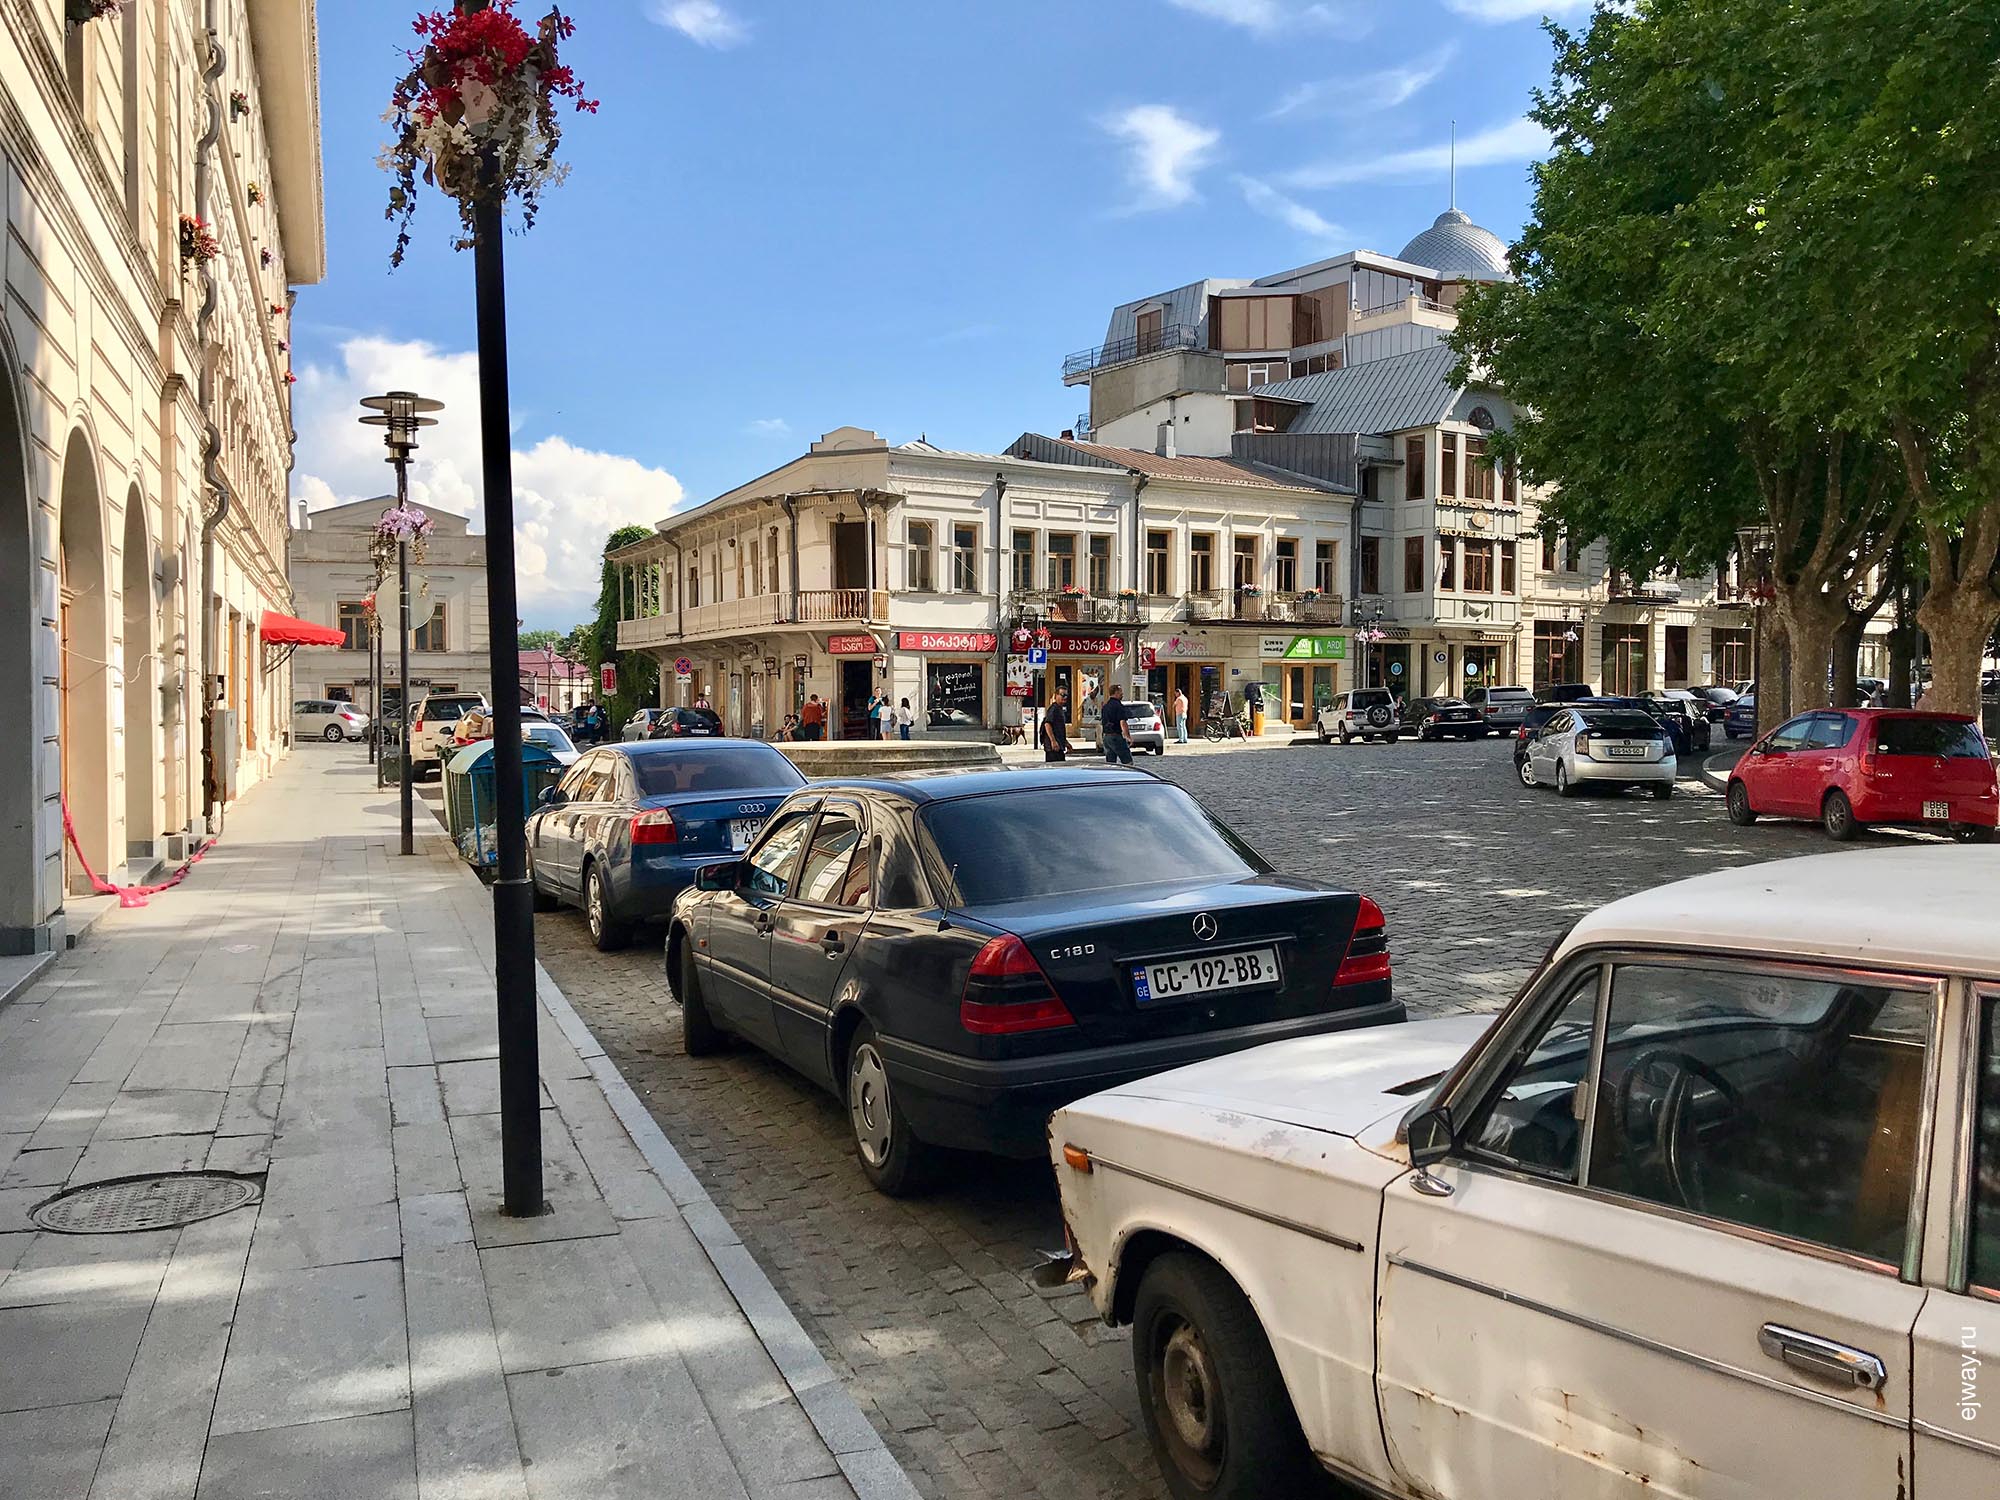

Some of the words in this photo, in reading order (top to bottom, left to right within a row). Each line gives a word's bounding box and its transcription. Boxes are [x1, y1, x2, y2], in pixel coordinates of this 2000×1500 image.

[922, 635, 977, 648] მარკეტი
[1069, 639, 1111, 651] შაურმა
[1326, 640, 1342, 650] ARDI
[1033, 650, 1043, 662] P
[1929, 810, 1948, 818] 858
[1051, 950, 1061, 960] C
[1064, 944, 1095, 957] 180
[1137, 987, 1149, 997] GE
[1153, 954, 1262, 994] CC-192-BB
